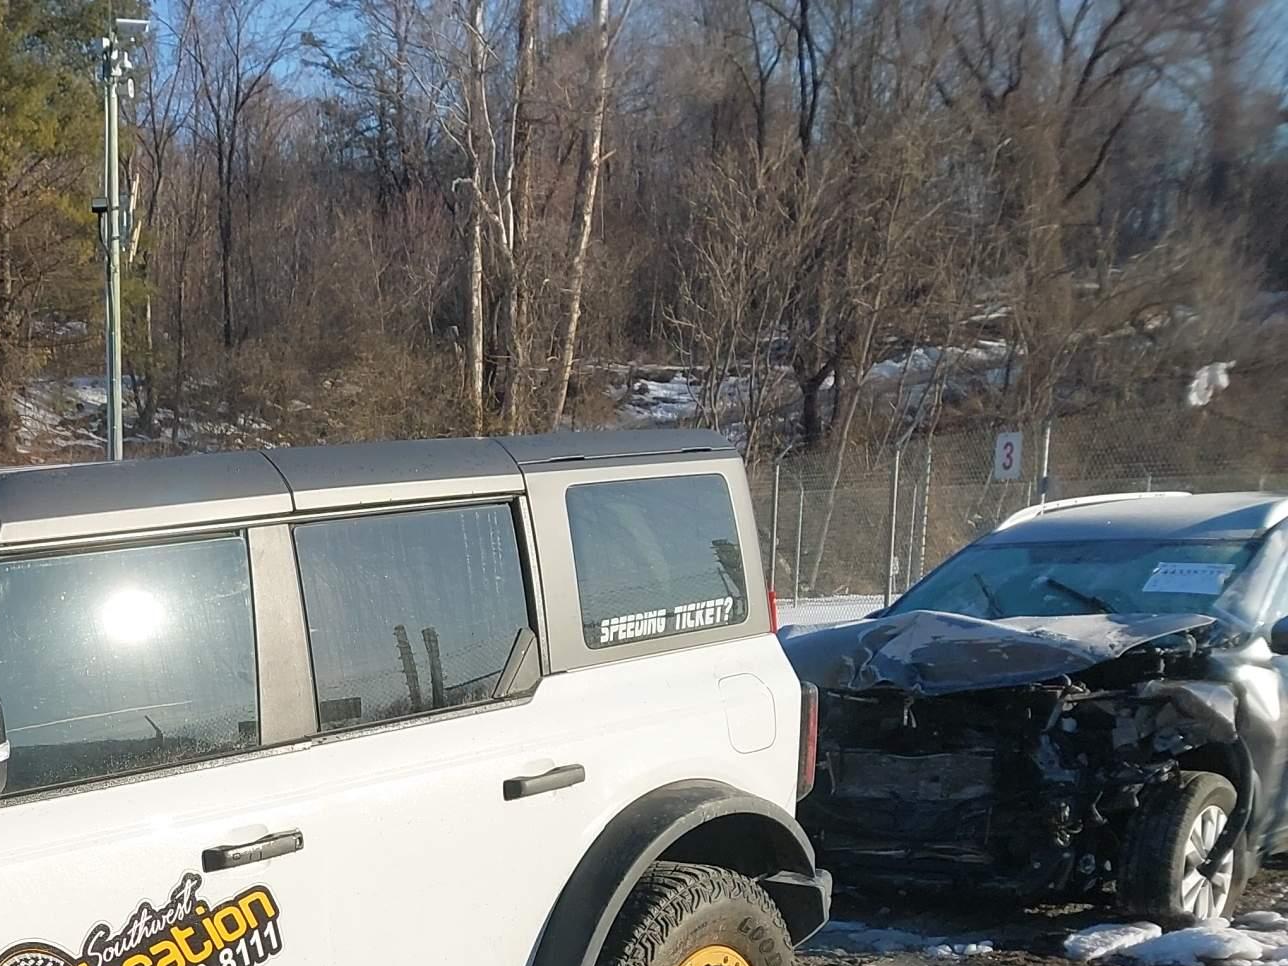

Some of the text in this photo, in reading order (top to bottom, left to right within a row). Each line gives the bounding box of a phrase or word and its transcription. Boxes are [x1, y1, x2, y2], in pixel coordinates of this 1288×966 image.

[1002, 441, 1014, 470] 3
[600, 596, 733, 643] SPEEDING TICKET?
